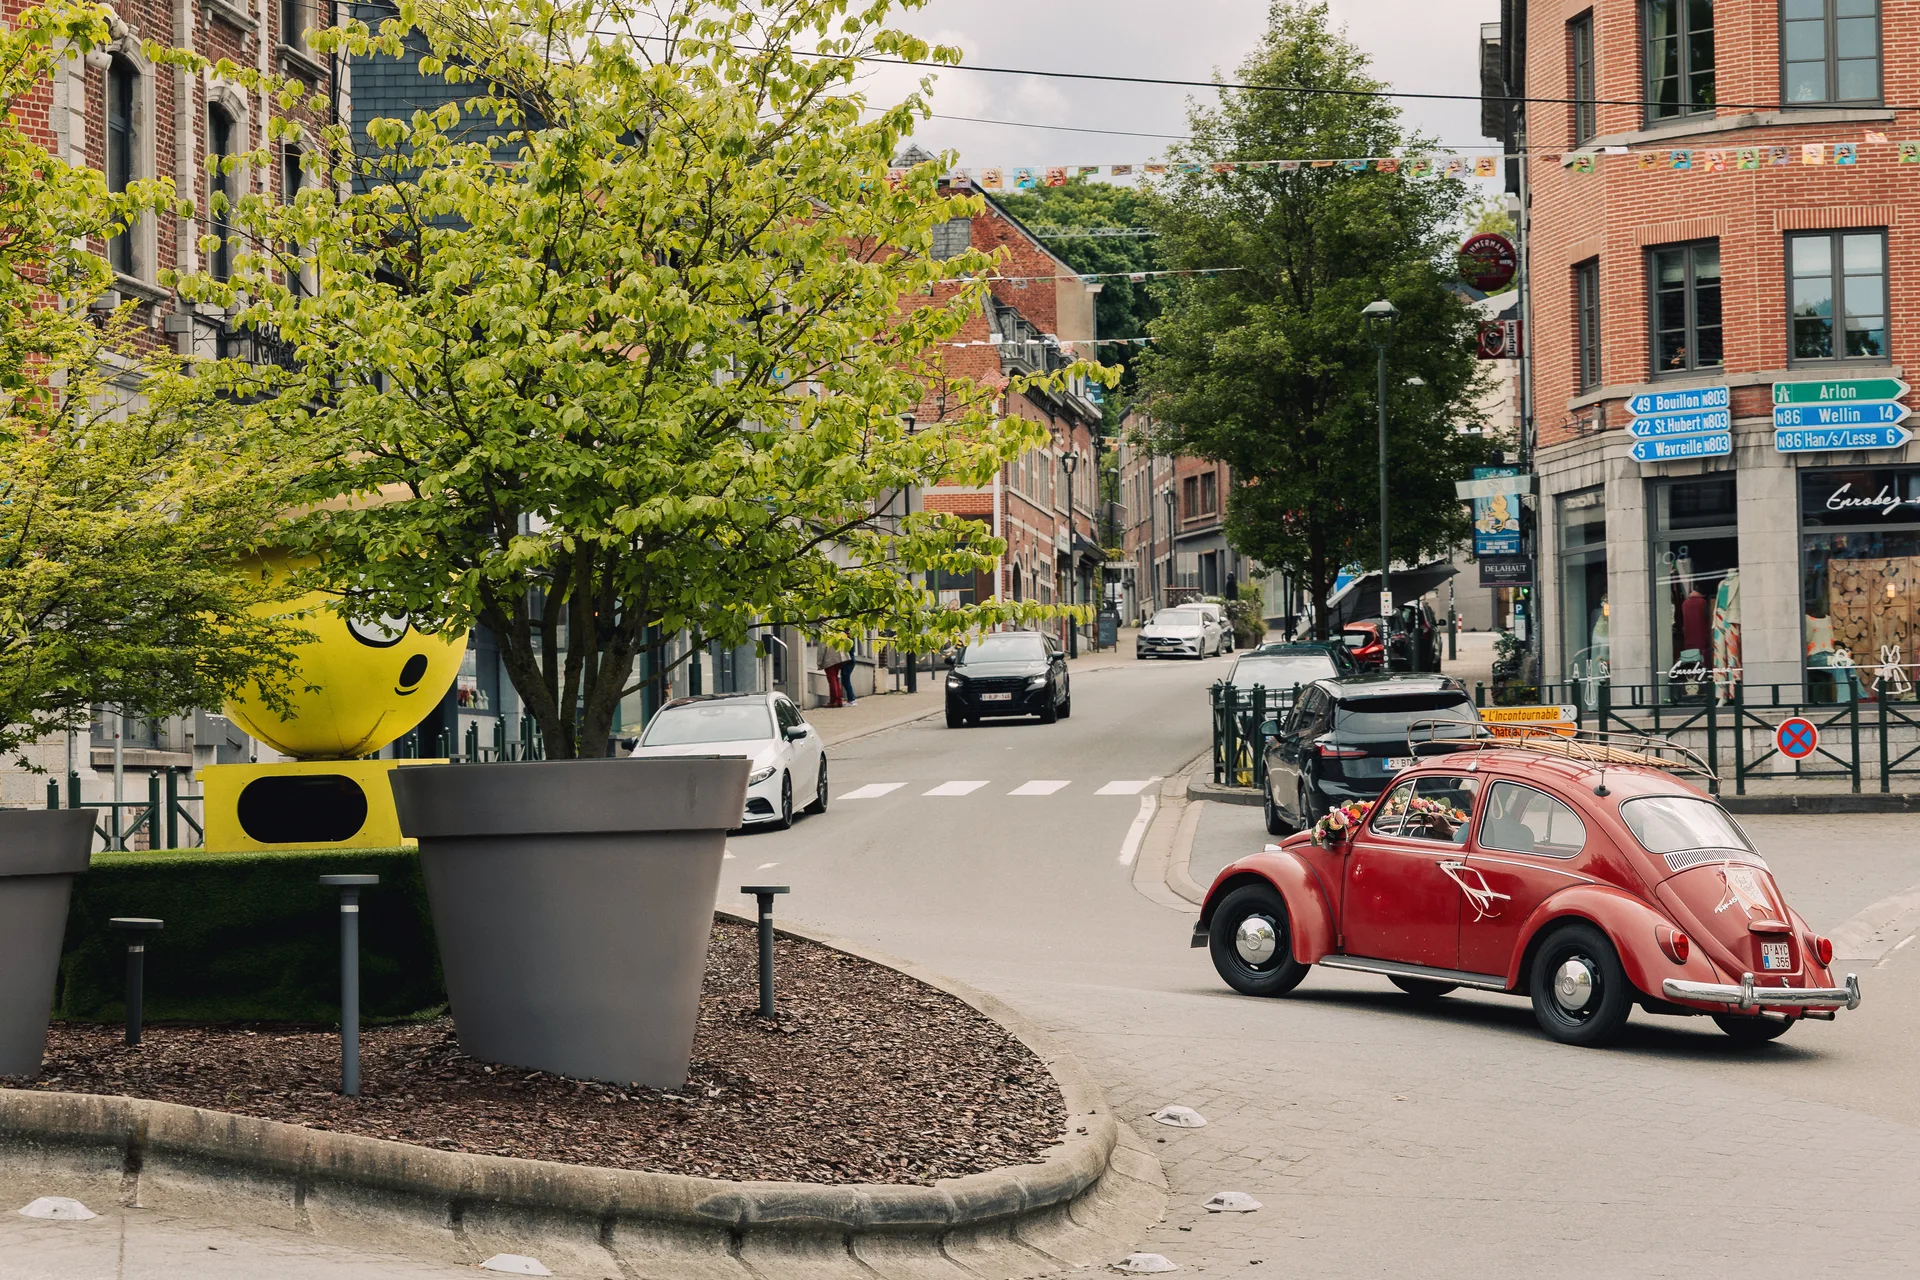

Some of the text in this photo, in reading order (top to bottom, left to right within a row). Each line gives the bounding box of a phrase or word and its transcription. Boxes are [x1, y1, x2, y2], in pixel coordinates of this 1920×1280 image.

[1467, 239, 1508, 257] IMMERMANS
[1506, 322, 1516, 355] Jupiler
[1636, 390, 1726, 412] 49 Bouillon N803
[1819, 385, 1857, 400] Arlon
[1637, 412, 1727, 435] 22 St.Hubert N803
[1776, 405, 1893, 425] N86 Wellin 14
[1638, 435, 1728, 458] 5 Wavreille N803
[1778, 430, 1895, 448] N86 Han/s/Lesse 6
[1484, 564, 1526, 572] DELAHAUT
[1515, 604, 1523, 614] P
[1488, 708, 1558, 722] L'Incontournable
[1775, 956, 1790, 968] 355
